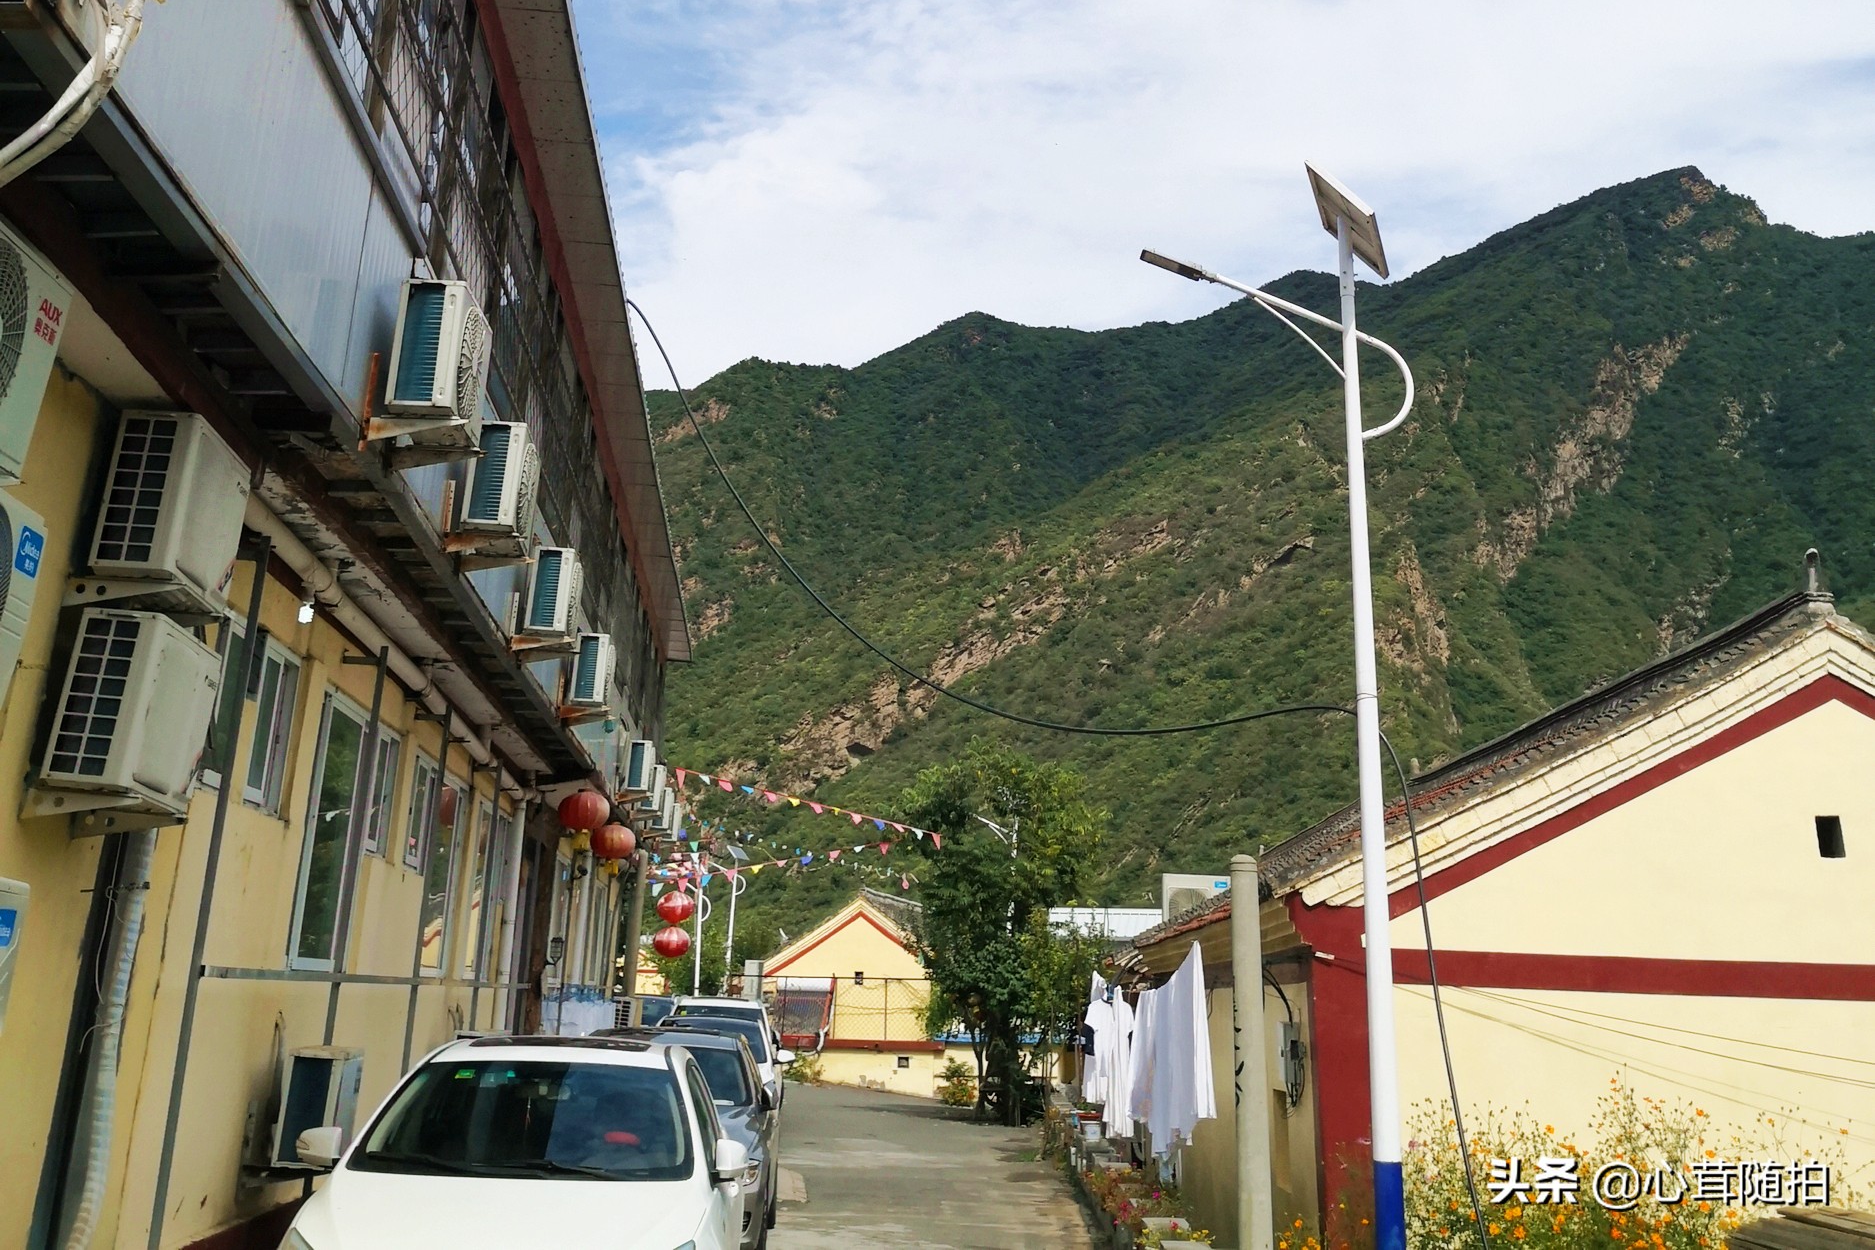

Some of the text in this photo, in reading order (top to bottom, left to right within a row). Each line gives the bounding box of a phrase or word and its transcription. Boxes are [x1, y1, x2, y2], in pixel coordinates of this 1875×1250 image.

[39, 298, 63, 327] AUX
[34, 317, 57, 346] 奥克斯
[21, 537, 40, 560] Midea
